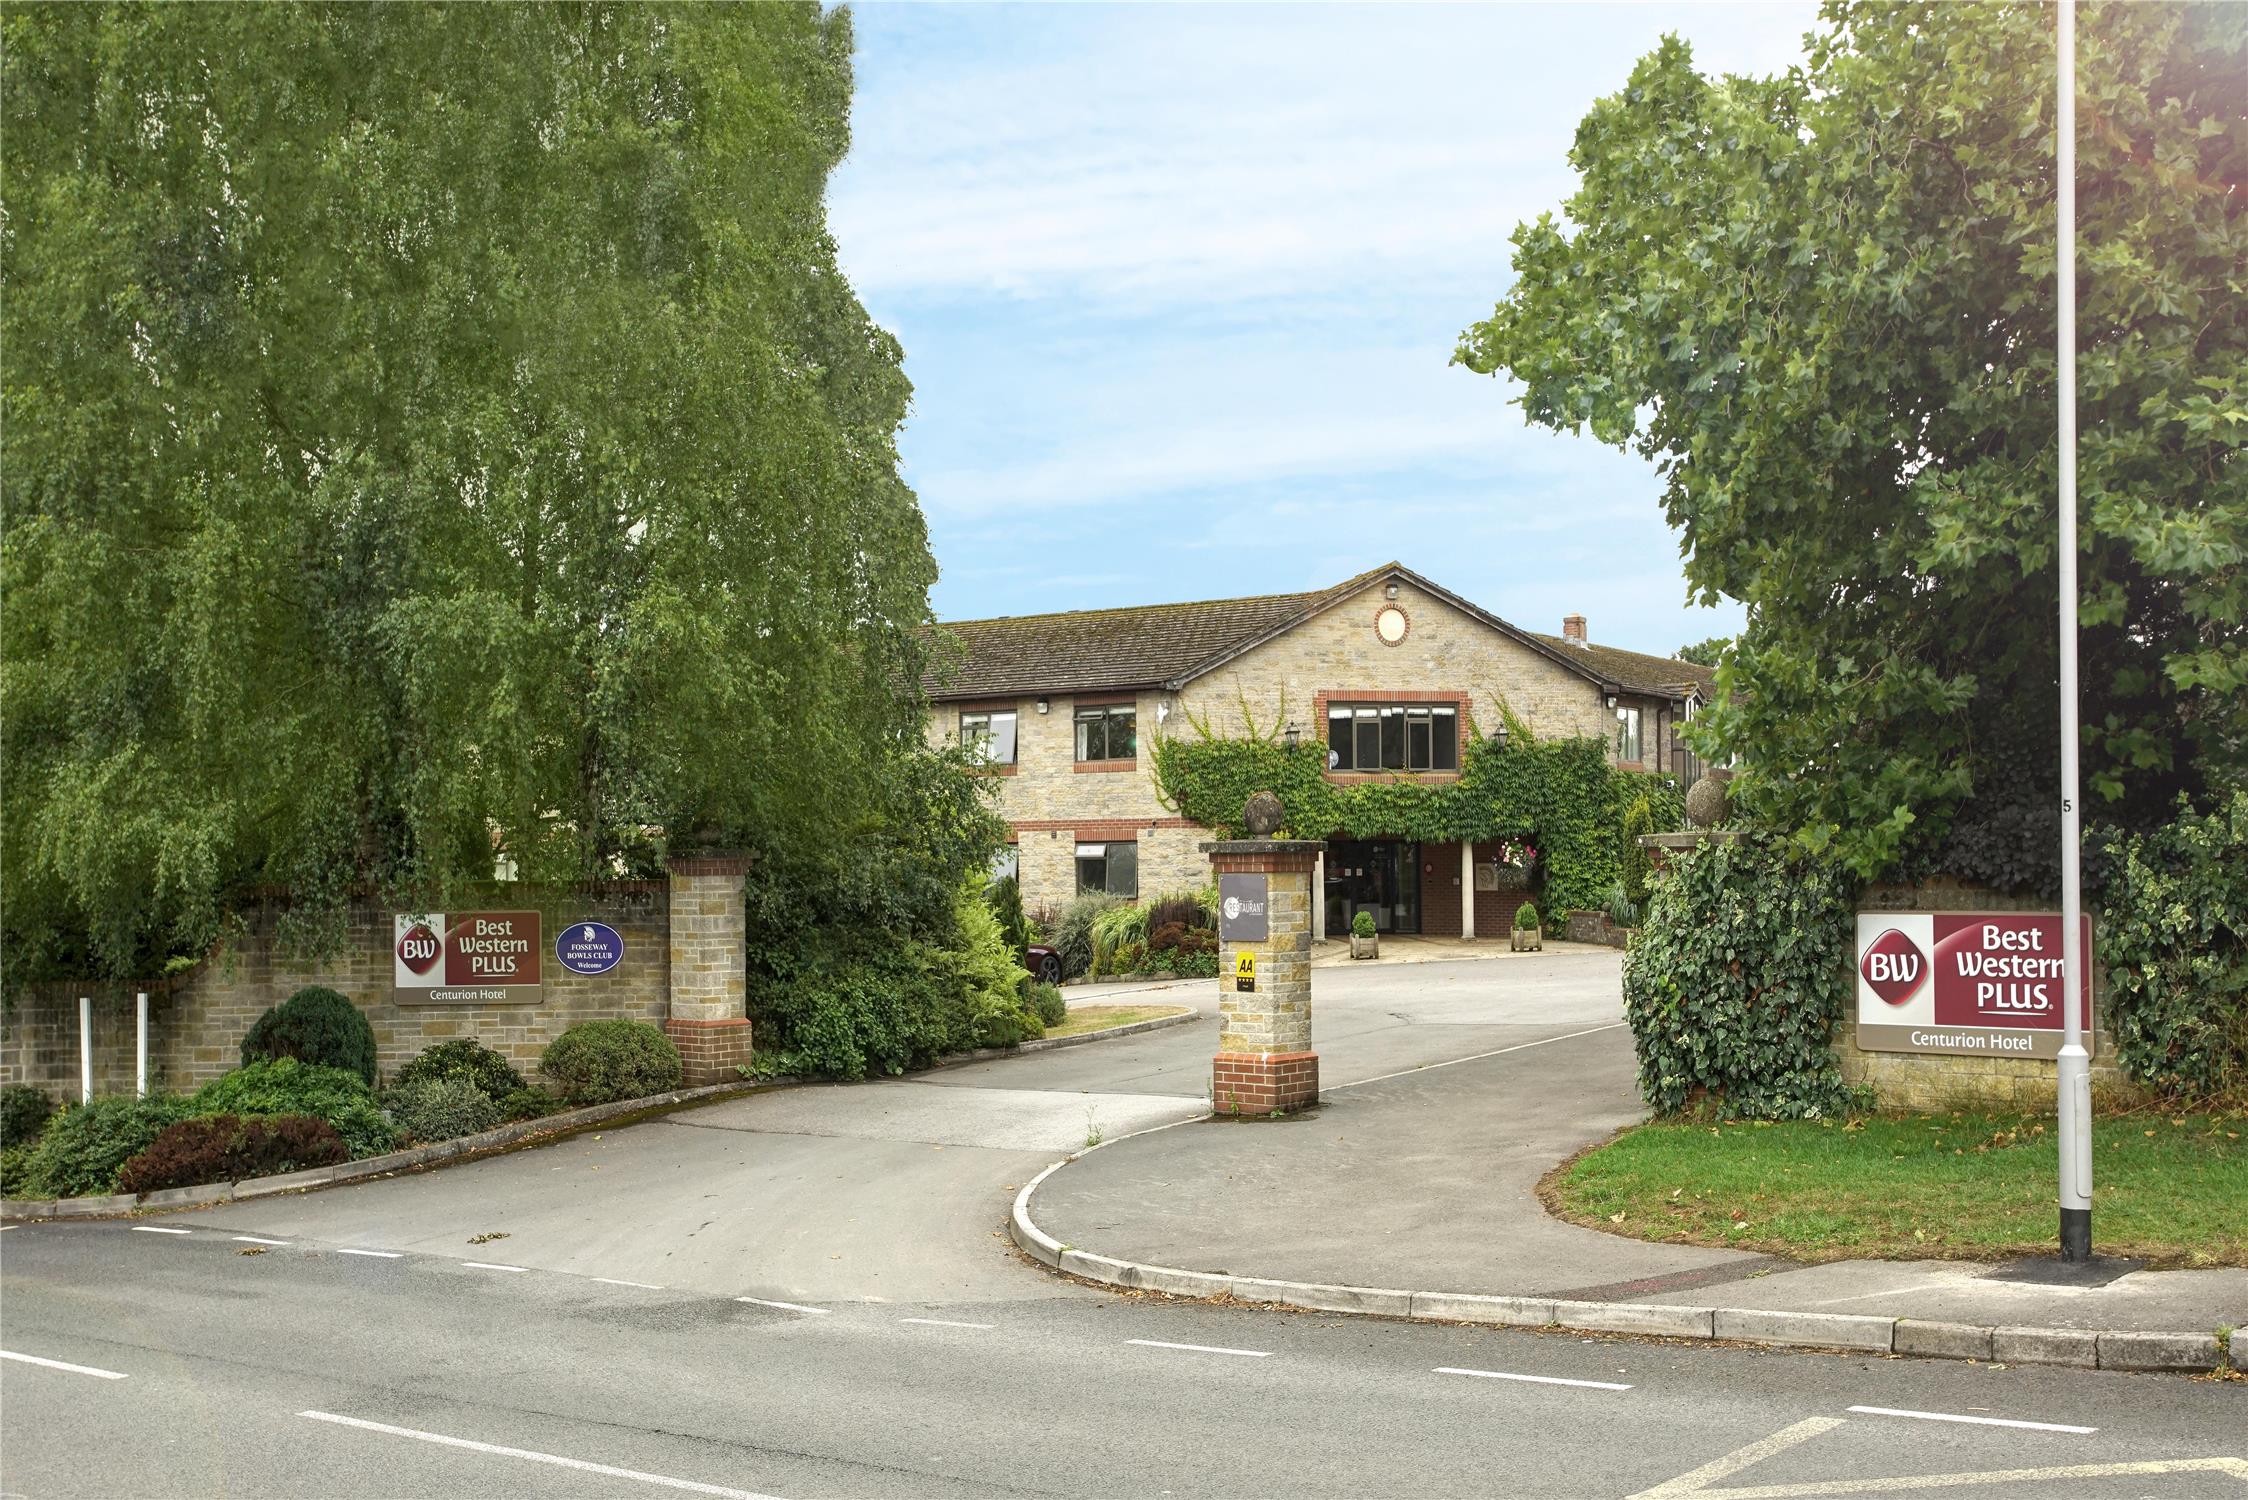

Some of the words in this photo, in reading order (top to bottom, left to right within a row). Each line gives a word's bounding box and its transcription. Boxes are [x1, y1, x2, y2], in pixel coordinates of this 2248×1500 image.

[2063, 799, 2071, 812] 5
[476, 919, 512, 936] Best
[459, 938, 528, 953] Western
[1983, 925, 2043, 951] Best
[403, 939, 436, 959] BW
[571, 943, 608, 951] FOSSEWAY
[472, 956, 516, 973] PLUS
[1239, 959, 1252, 973] AA
[1870, 953, 1918, 982] BW
[1956, 951, 2065, 978] Western
[430, 989, 477, 1000] Centurion
[480, 989, 506, 1000] Hotel
[1977, 983, 2048, 1010] PLUS
[1911, 1031, 1985, 1049] Centurion
[1990, 1034, 2033, 1050] Hotel
